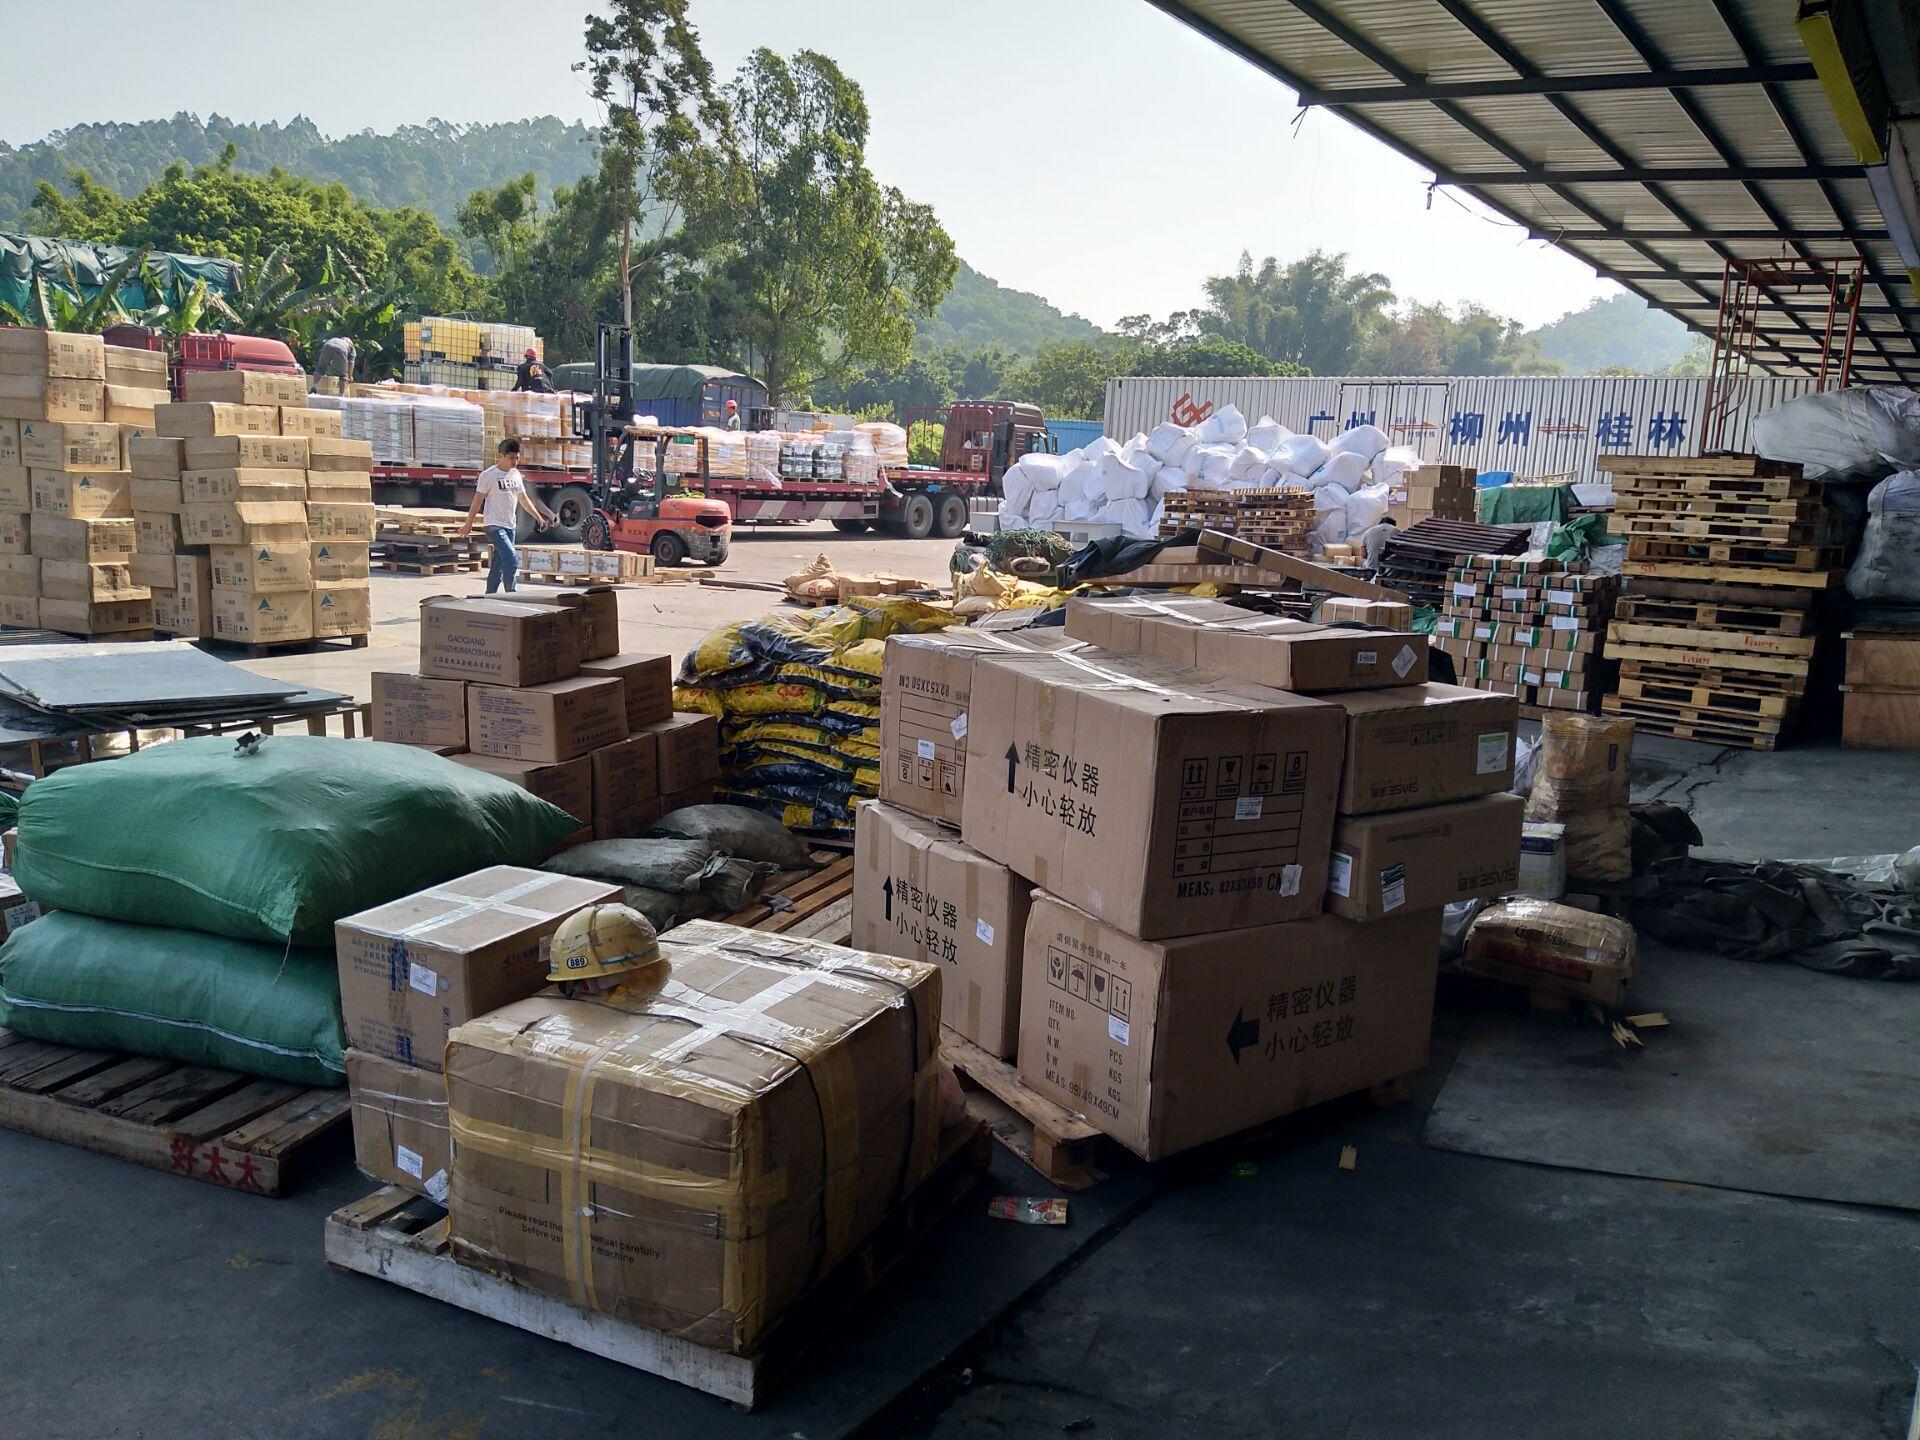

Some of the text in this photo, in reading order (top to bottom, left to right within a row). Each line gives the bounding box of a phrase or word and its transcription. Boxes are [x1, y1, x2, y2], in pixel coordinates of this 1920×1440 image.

[1450, 411, 1531, 446] 柳州
[1595, 411, 1687, 448] 桂林
[899, 675, 910, 688] CM
[1024, 740, 1099, 797] 精密仪器
[1022, 780, 1096, 838] 小心轻放
[896, 877, 957, 930] 精密仪器
[1177, 880, 1214, 898] MEAS:
[896, 912, 957, 965] 小心轻放
[1049, 999, 1065, 1015] ITEM
[1266, 975, 1356, 1023] 精密仪器
[1264, 1012, 1355, 1061] 小心轻放
[1109, 1049, 1123, 1066] PCS
[1045, 1069, 1066, 1091] MEAS:
[1107, 1086, 1121, 1103] KGS
[1108, 1069, 1122, 1085] KGS
[499, 1206, 527, 1222] Please
[528, 1216, 548, 1228] read
[549, 1220, 563, 1232] the
[619, 1239, 661, 1259] carefully
[522, 1224, 549, 1239] before
[597, 1247, 635, 1264] machine
